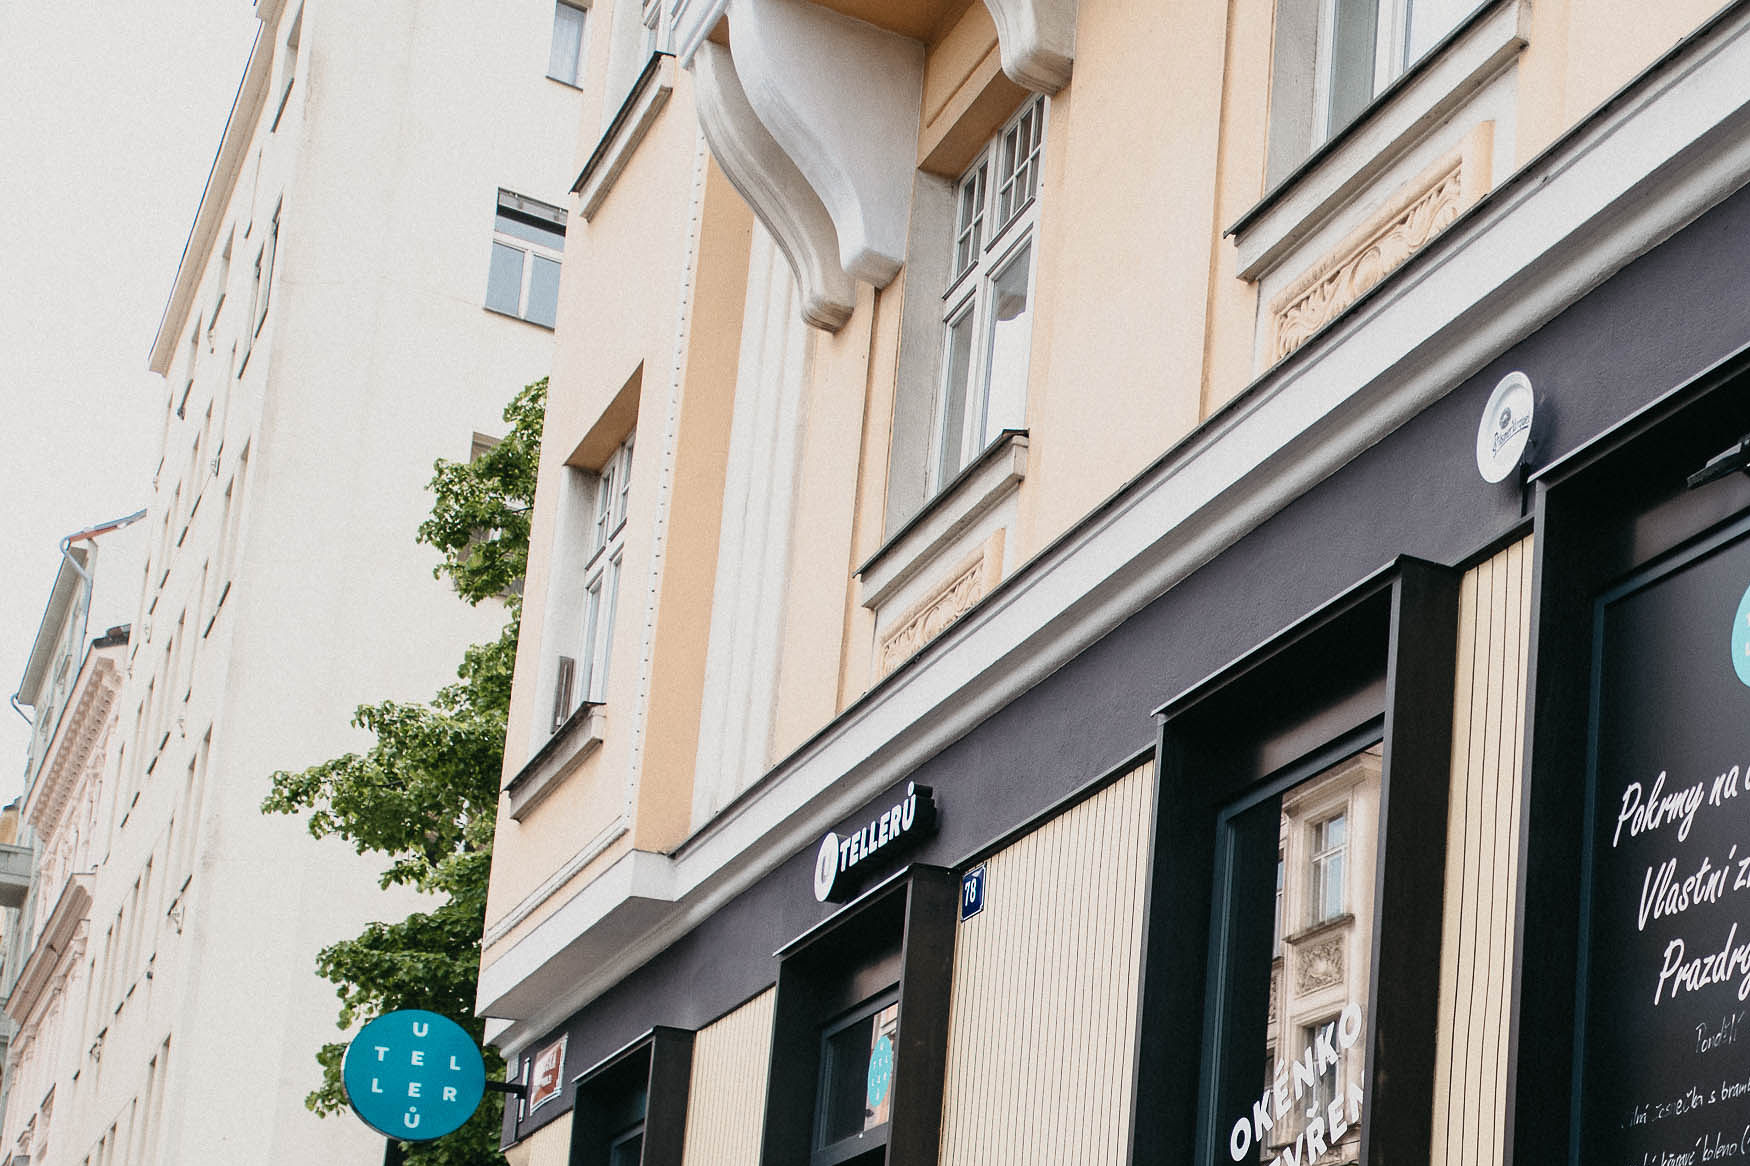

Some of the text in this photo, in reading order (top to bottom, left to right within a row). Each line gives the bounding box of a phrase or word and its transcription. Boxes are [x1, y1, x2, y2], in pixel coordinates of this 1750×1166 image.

[1612, 770, 1704, 848] Pokrmy
[1708, 765, 1738, 806] na
[839, 780, 917, 873] TELLERŮ
[964, 877, 977, 907] 78
[1637, 844, 1738, 931] Vlastní
[412, 1021, 429, 1038] U
[1230, 1001, 1363, 1163] OKÉNKO
[1707, 1090, 1717, 1105] s
[403, 1106, 420, 1129] Ů
[1702, 1131, 1738, 1163] koleno
